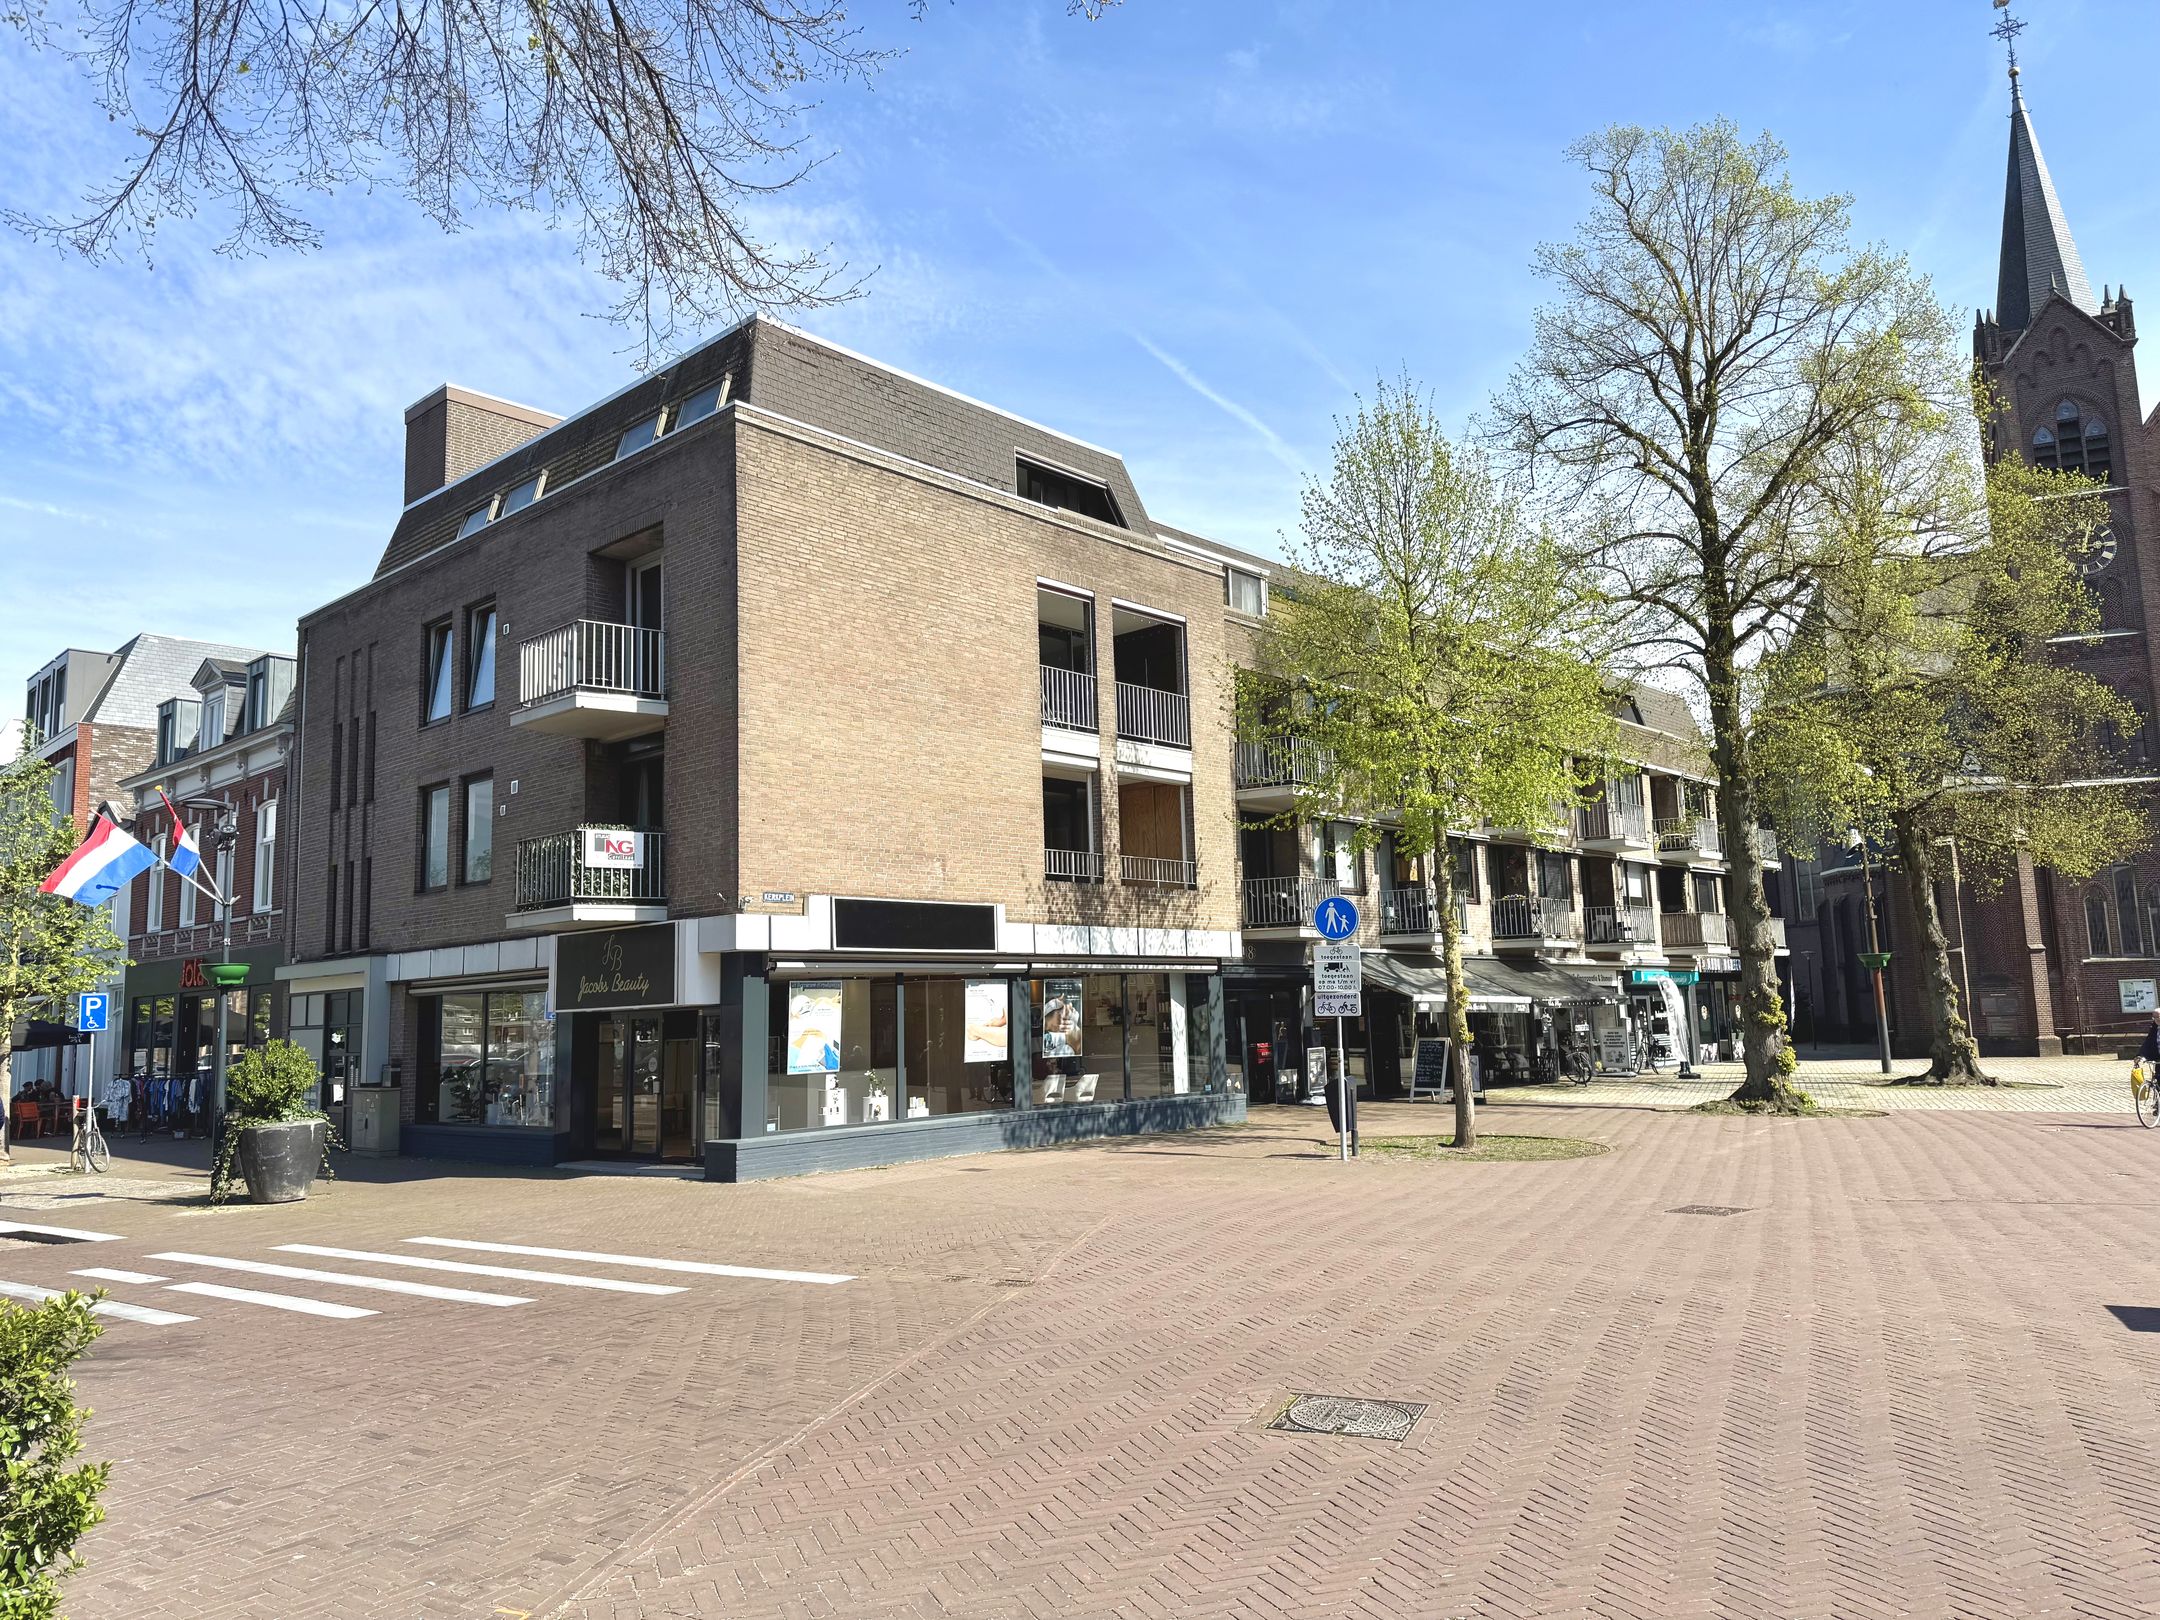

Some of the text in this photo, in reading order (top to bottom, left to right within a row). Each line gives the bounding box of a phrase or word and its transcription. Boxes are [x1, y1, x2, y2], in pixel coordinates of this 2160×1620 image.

[577, 972, 650, 1002] Jacobs Beauty
[86, 997, 102, 1017] P
